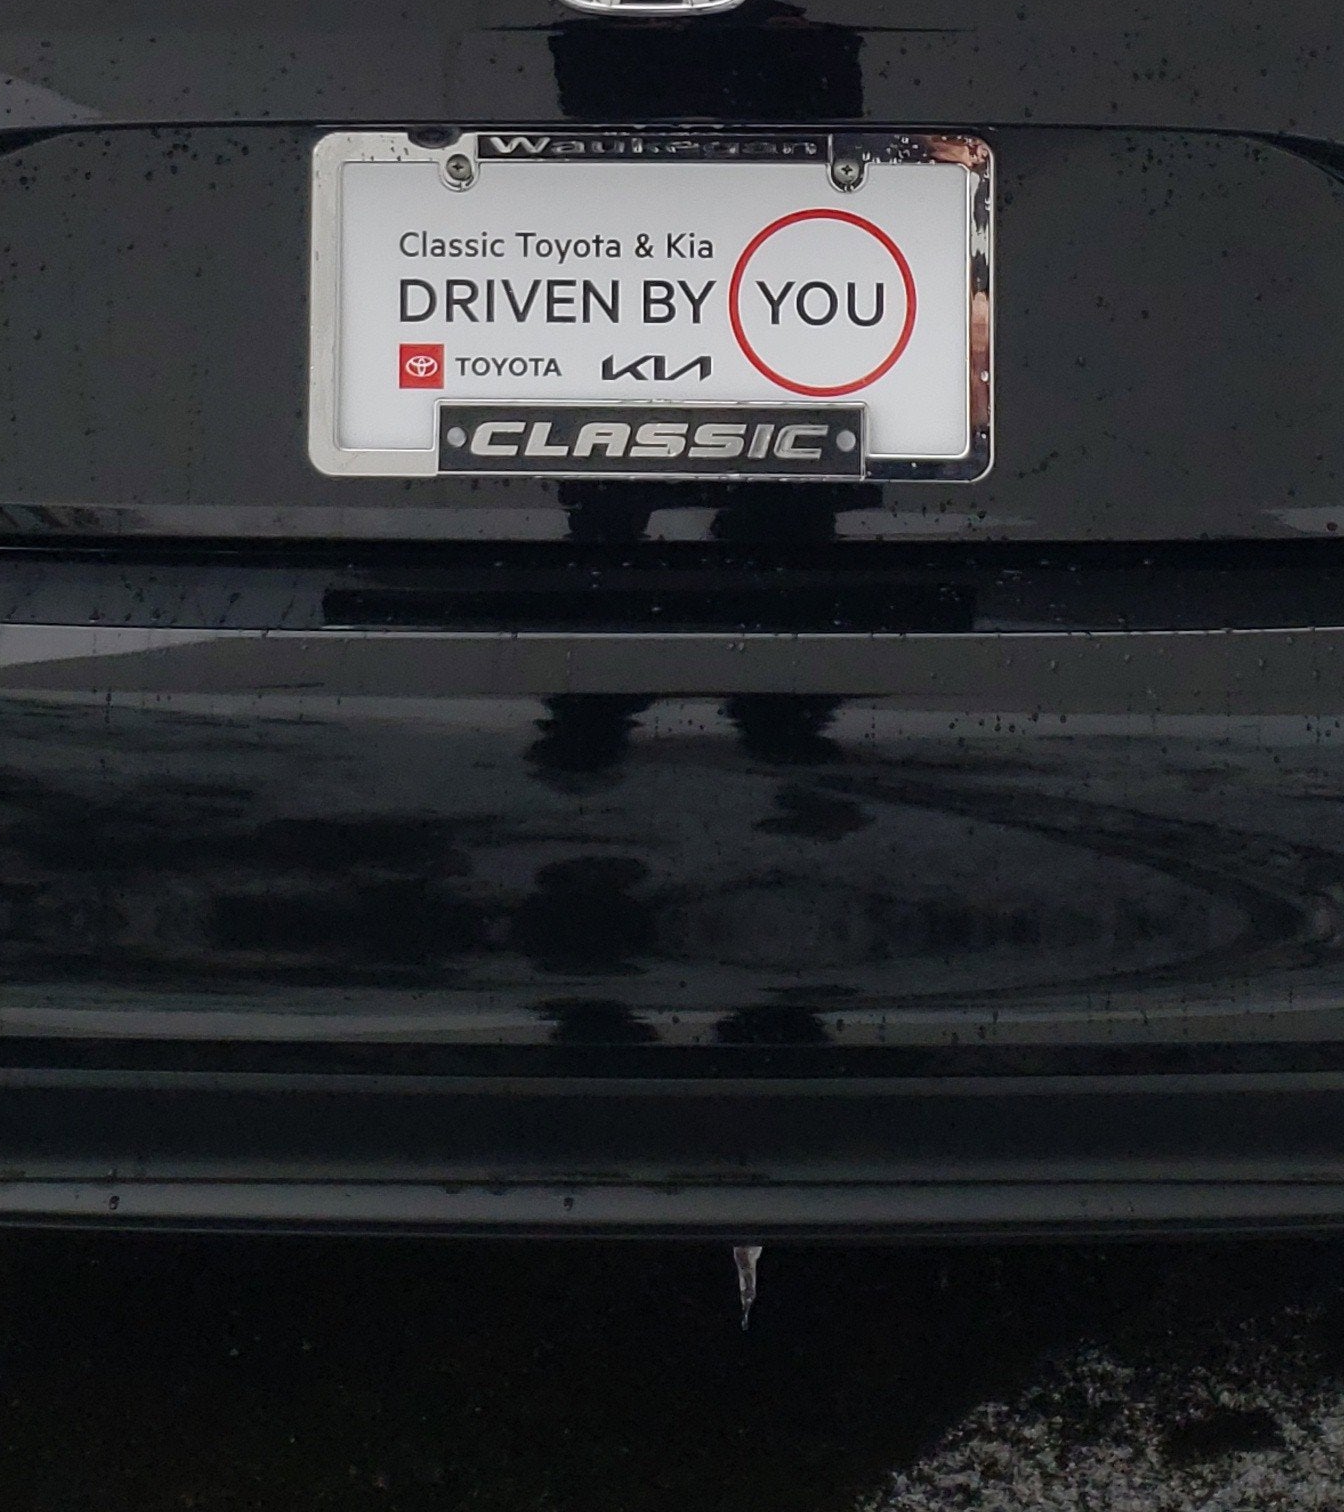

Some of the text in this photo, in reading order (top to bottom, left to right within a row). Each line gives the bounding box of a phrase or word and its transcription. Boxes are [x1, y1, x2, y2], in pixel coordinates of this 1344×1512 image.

[399, 231, 714, 264] Classic Toyota & Kia
[399, 279, 885, 326] DRIVEN BY YOU
[455, 357, 563, 378] TOYOTA
[470, 422, 828, 459] CLASSIC
